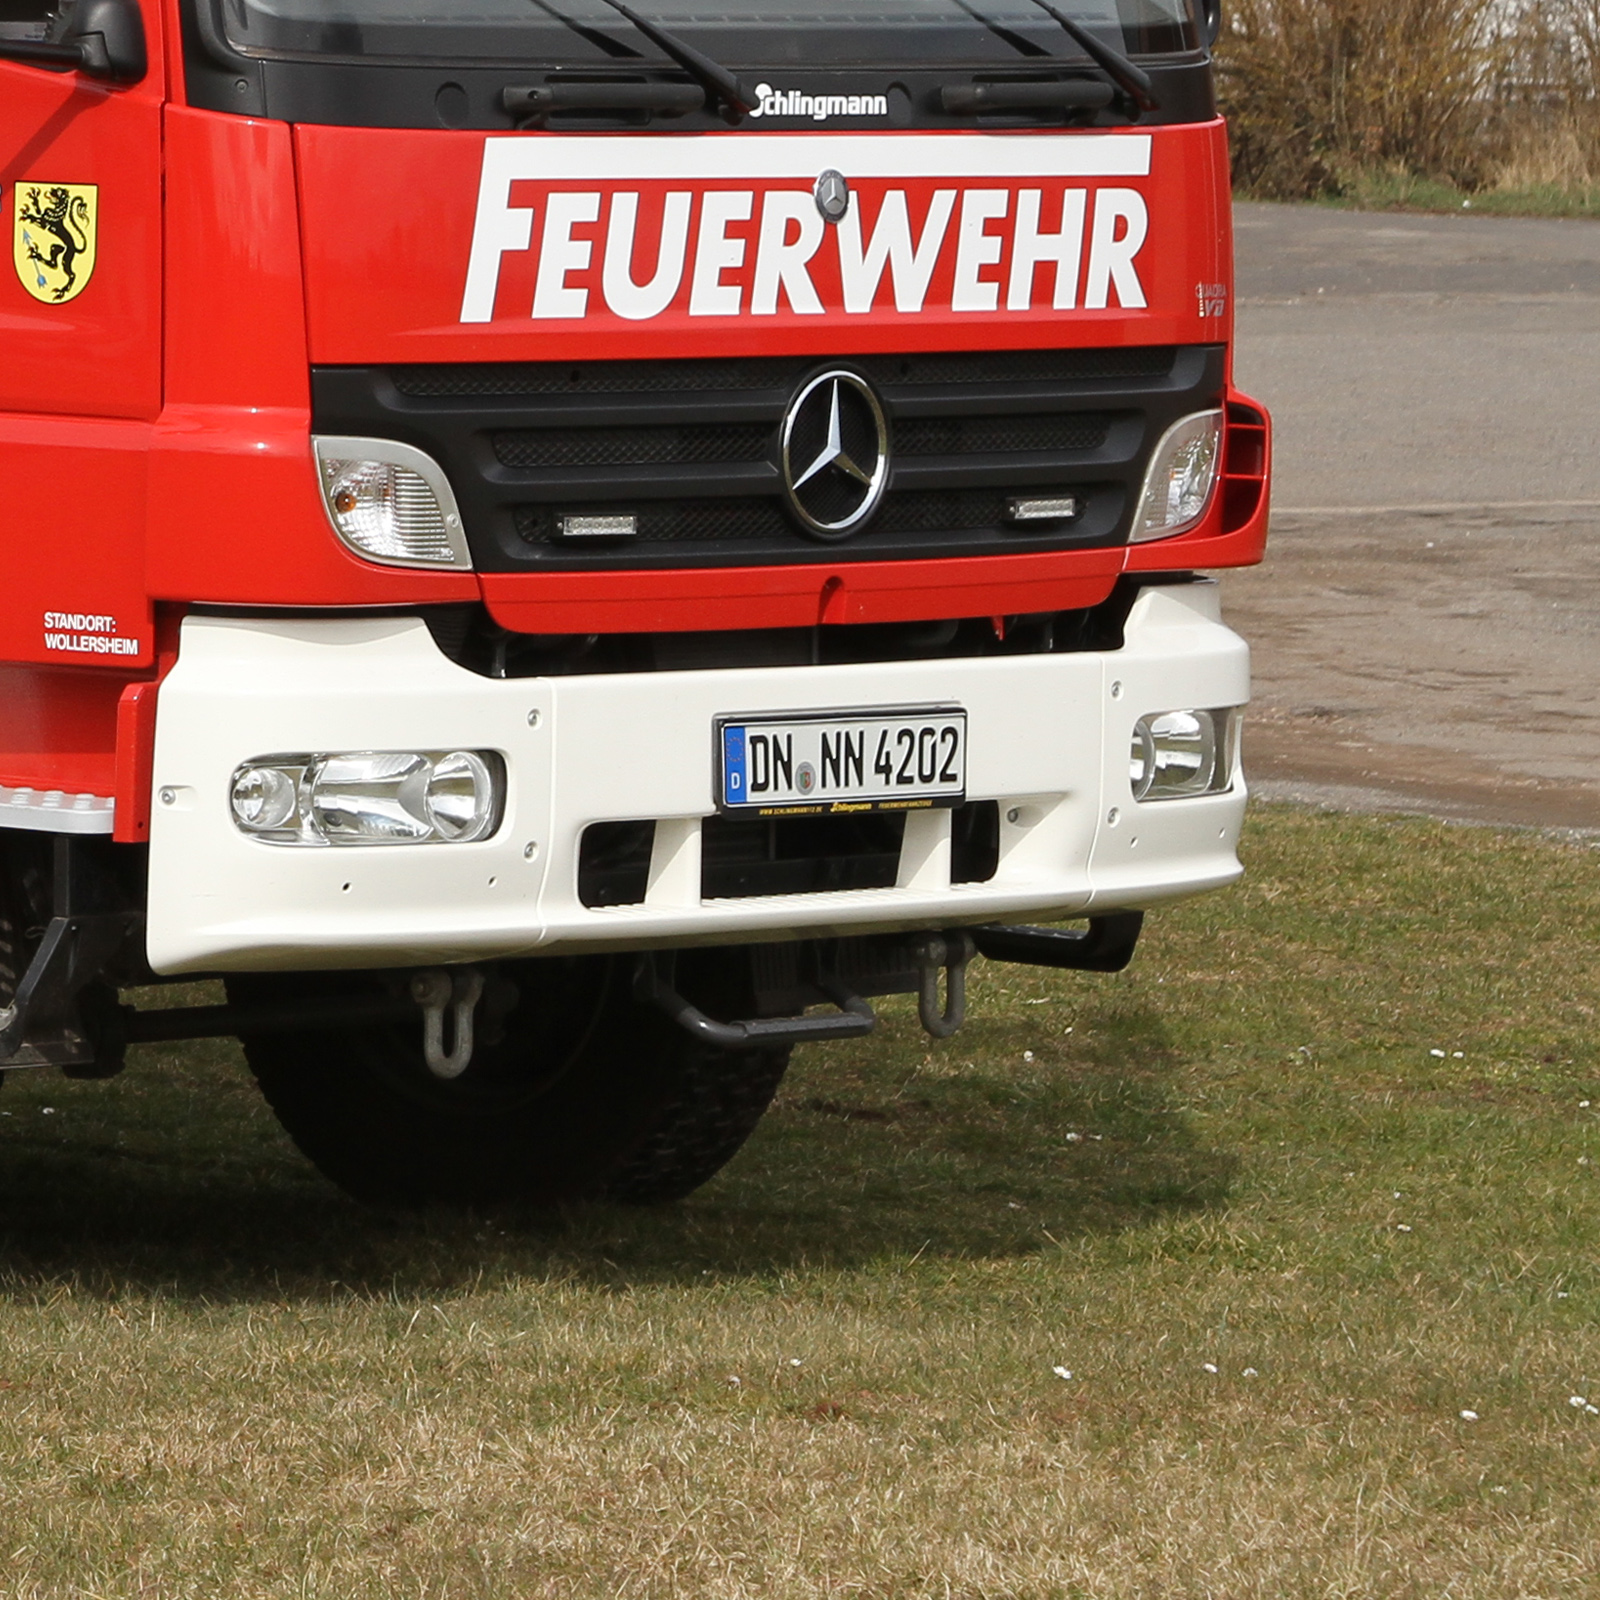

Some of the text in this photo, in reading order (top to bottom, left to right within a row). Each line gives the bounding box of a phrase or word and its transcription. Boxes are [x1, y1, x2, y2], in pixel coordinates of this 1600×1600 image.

[748, 82, 888, 121] Schlingmann
[459, 136, 1153, 324] FEUERWEHR
[43, 611, 117, 633] STANDORT:
[44, 633, 138, 655] WOLLERSHEIM
[749, 725, 959, 792] DN NN 4202
[730, 771, 741, 790] D
